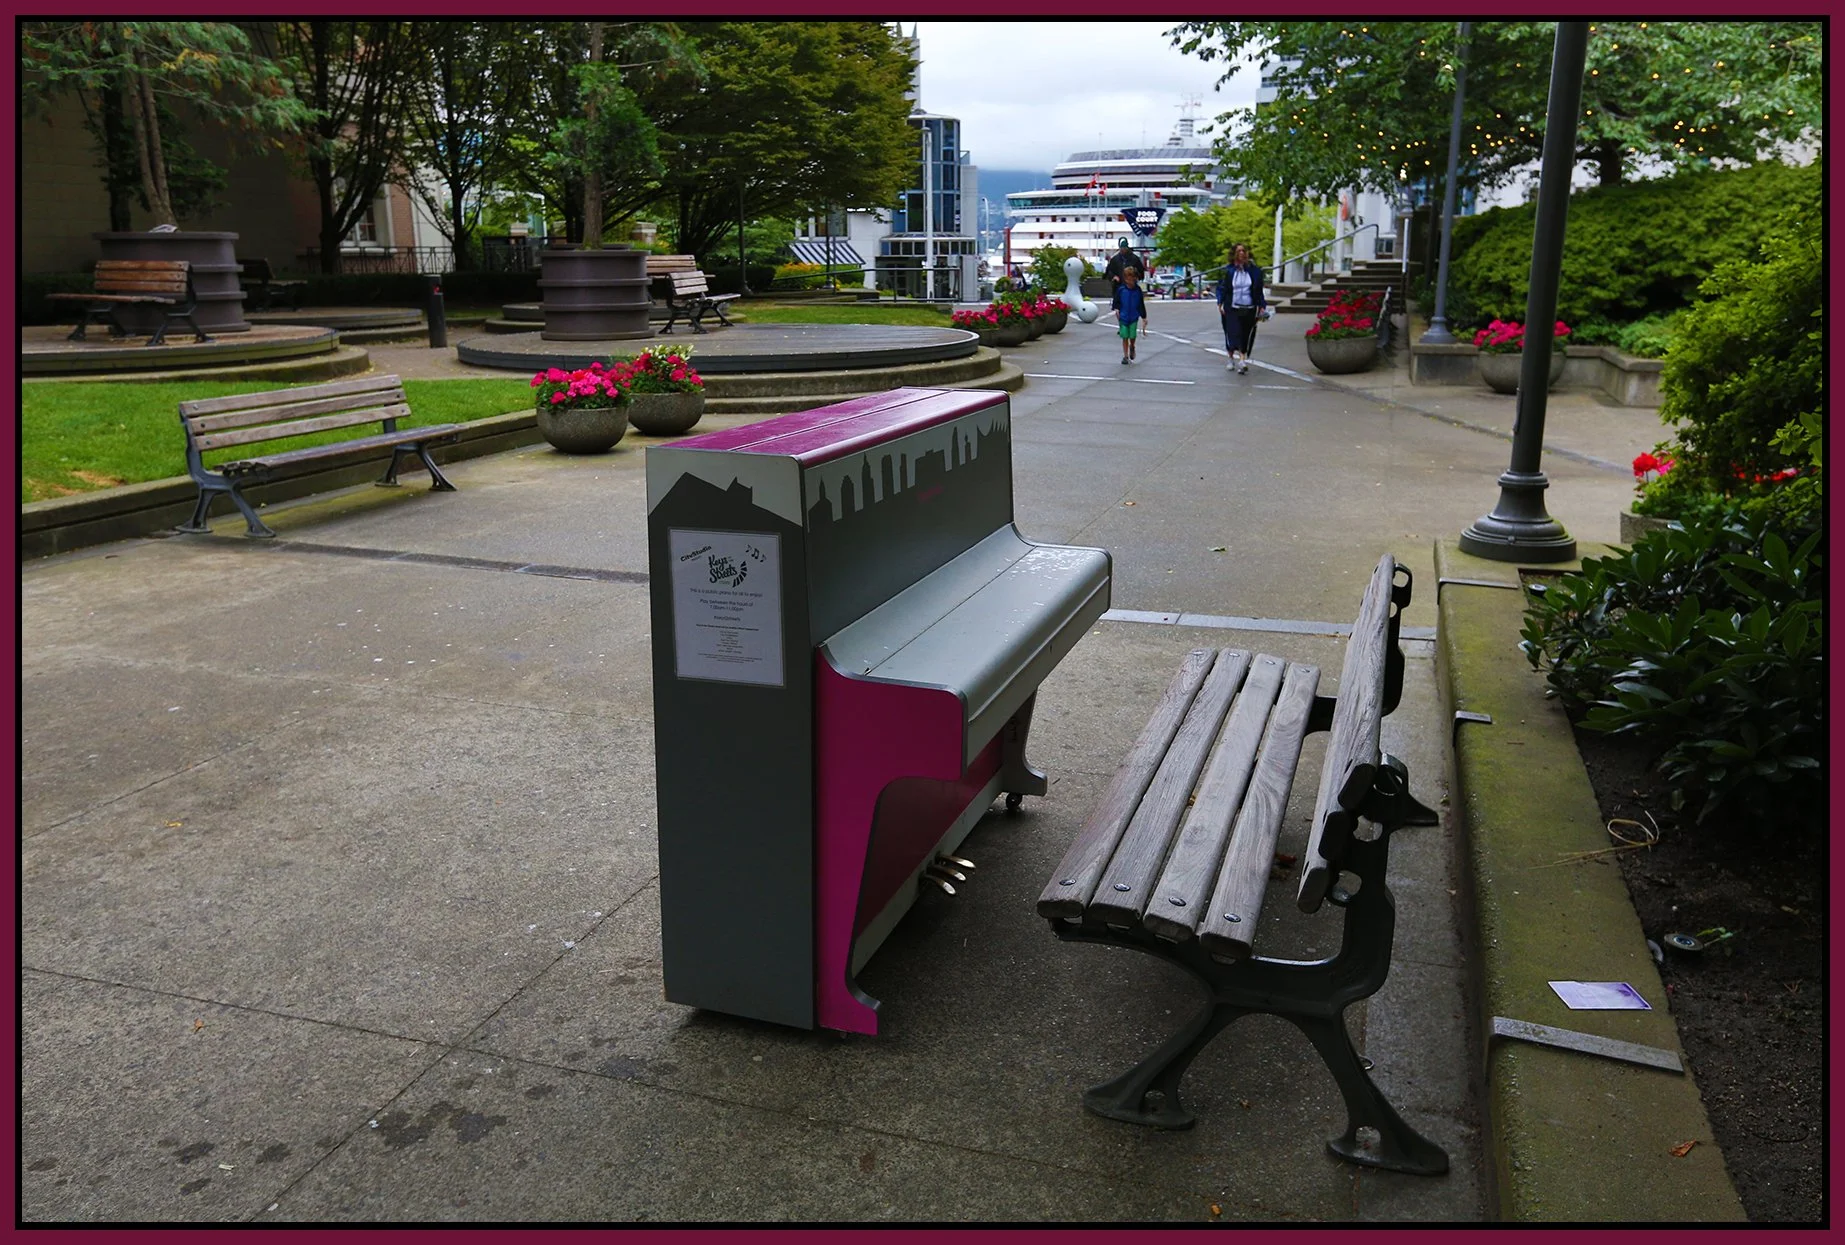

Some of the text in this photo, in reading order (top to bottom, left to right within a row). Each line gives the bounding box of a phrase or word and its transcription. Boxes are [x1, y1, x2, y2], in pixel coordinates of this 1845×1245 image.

[680, 545, 712, 562] CityStudio
[708, 554, 728, 571] Keys
[709, 564, 738, 583] Streets
